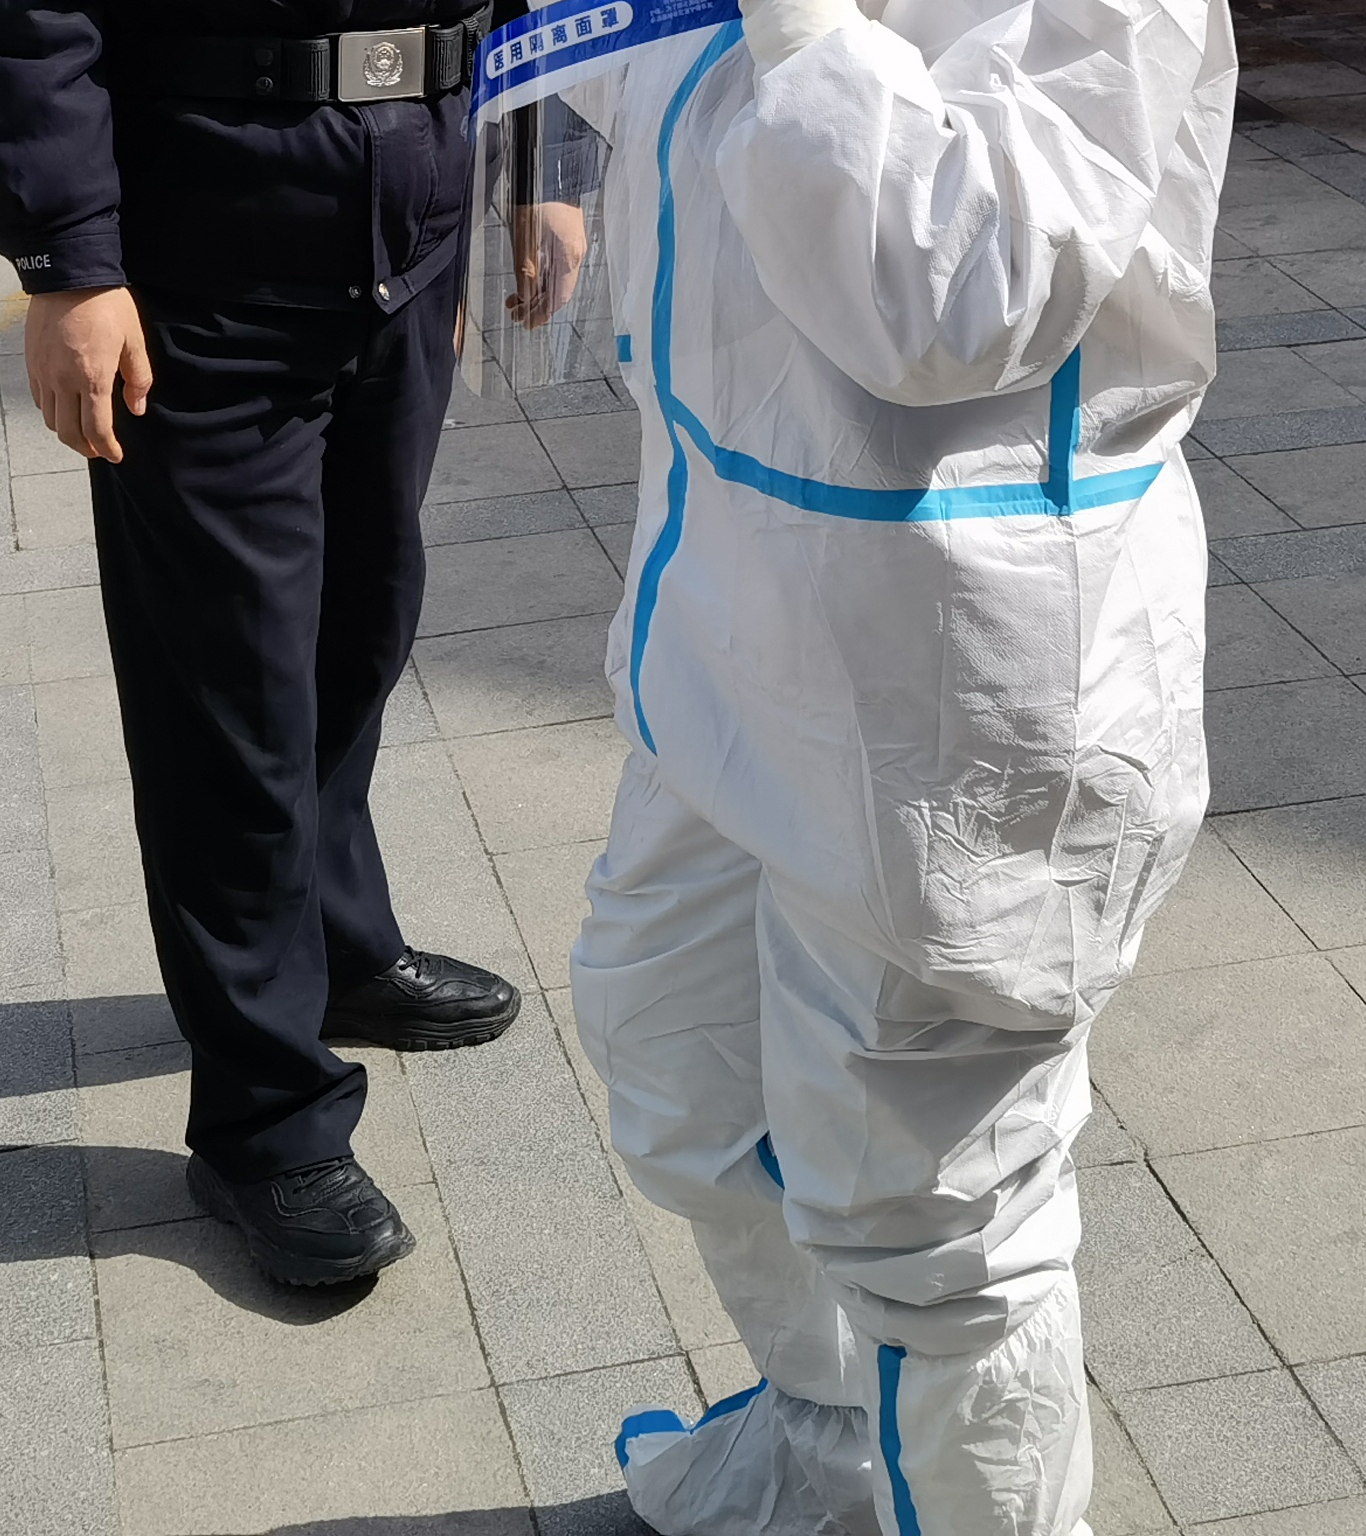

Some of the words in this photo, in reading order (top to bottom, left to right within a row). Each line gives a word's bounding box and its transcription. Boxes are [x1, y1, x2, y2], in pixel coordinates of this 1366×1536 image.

[492, 7, 621, 73] 医用隔离面罩
[15, 253, 52, 272] POLICE
